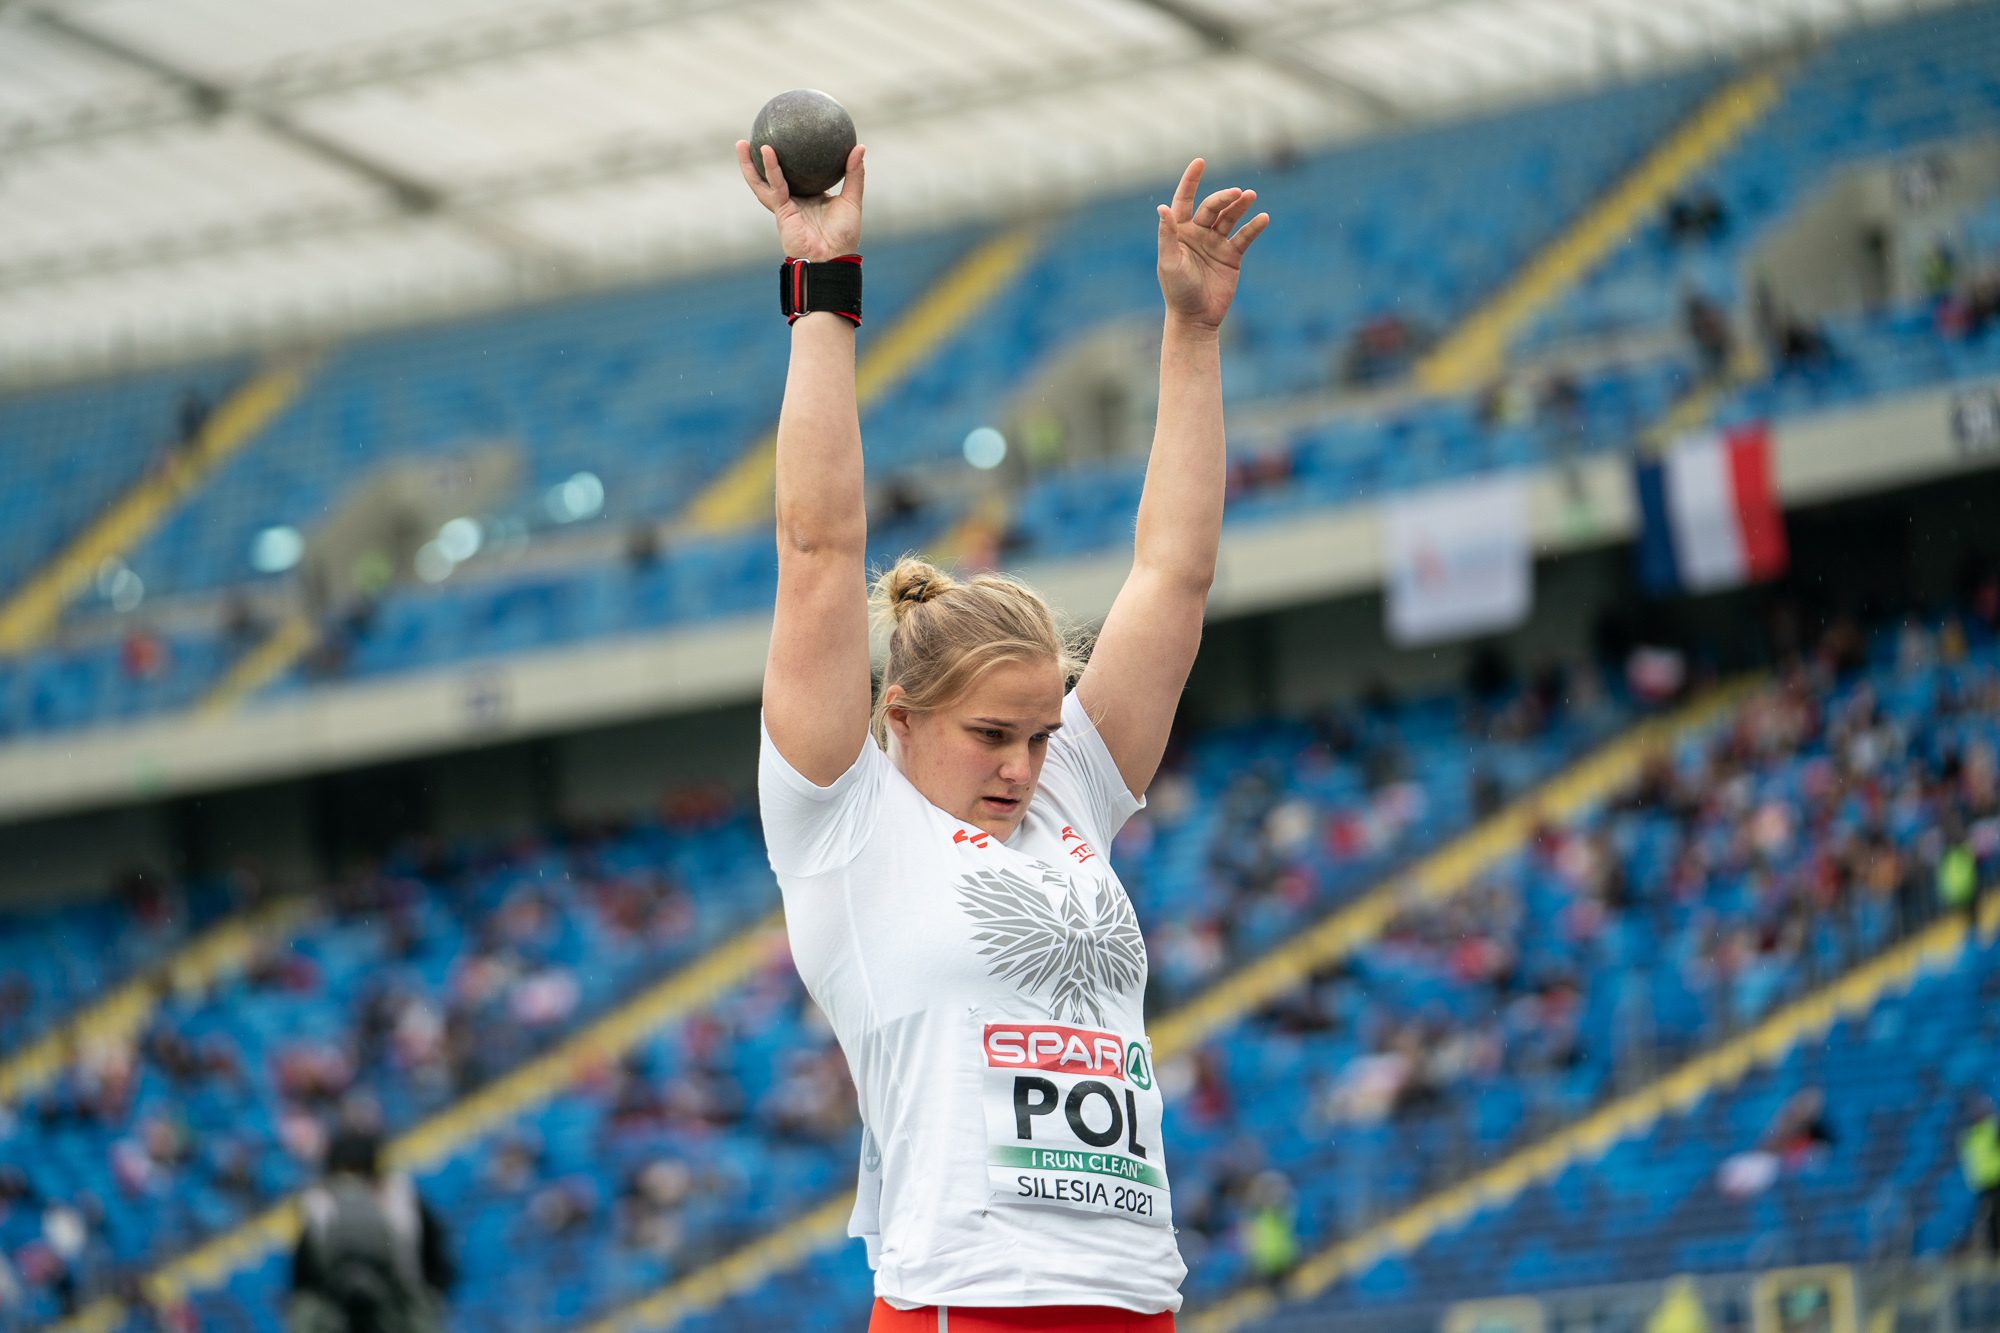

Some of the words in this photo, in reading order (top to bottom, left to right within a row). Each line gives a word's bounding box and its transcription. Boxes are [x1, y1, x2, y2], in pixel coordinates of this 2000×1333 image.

[988, 1031, 1122, 1074] SPAR
[1013, 1076, 1147, 1159] POL
[1031, 1150, 1037, 1166] I
[1042, 1151, 1084, 1169] RUN
[1017, 1176, 1109, 1206] SILESIA
[1114, 1186, 1153, 1217] 2021
